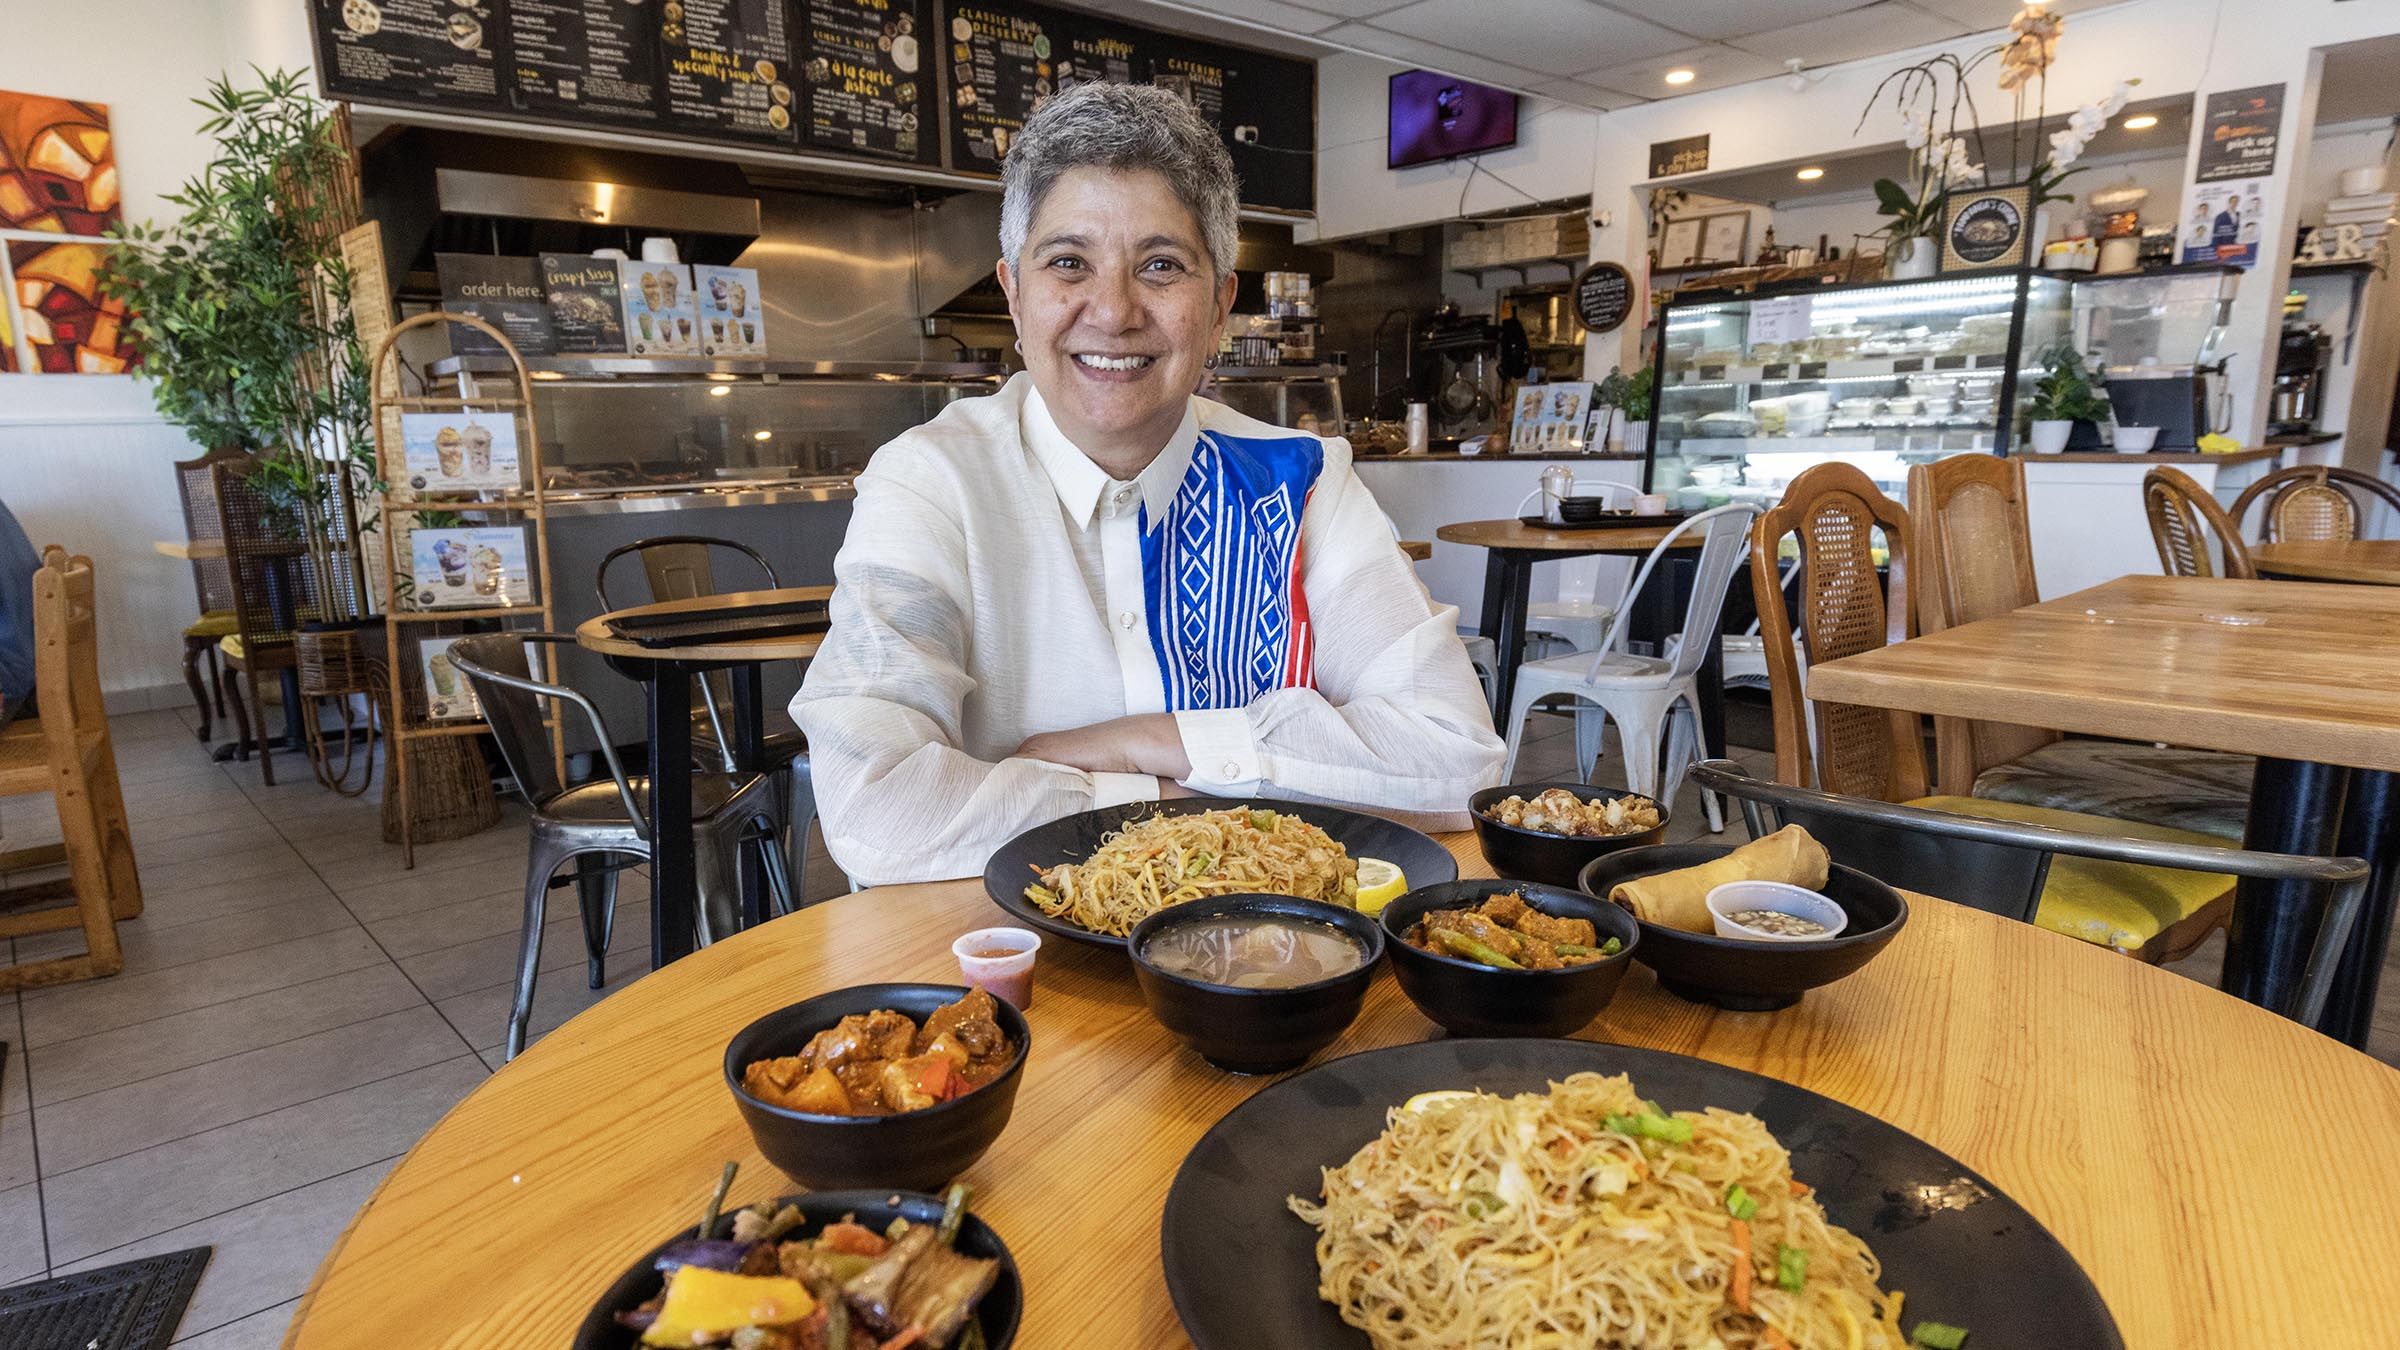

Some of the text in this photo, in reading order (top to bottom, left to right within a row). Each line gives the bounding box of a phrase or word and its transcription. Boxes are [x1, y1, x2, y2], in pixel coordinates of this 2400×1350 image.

[958, 7, 1008, 27] CLASSIC
[973, 22, 1034, 44] DESSERTS
[1073, 40, 1127, 61] DESSERTS
[843, 62, 856, 79] la
[858, 67, 893, 86] carte
[1168, 58, 1223, 78] CATERING
[548, 267, 615, 287] Crispy Sisig
[462, 281, 544, 298] order here.
